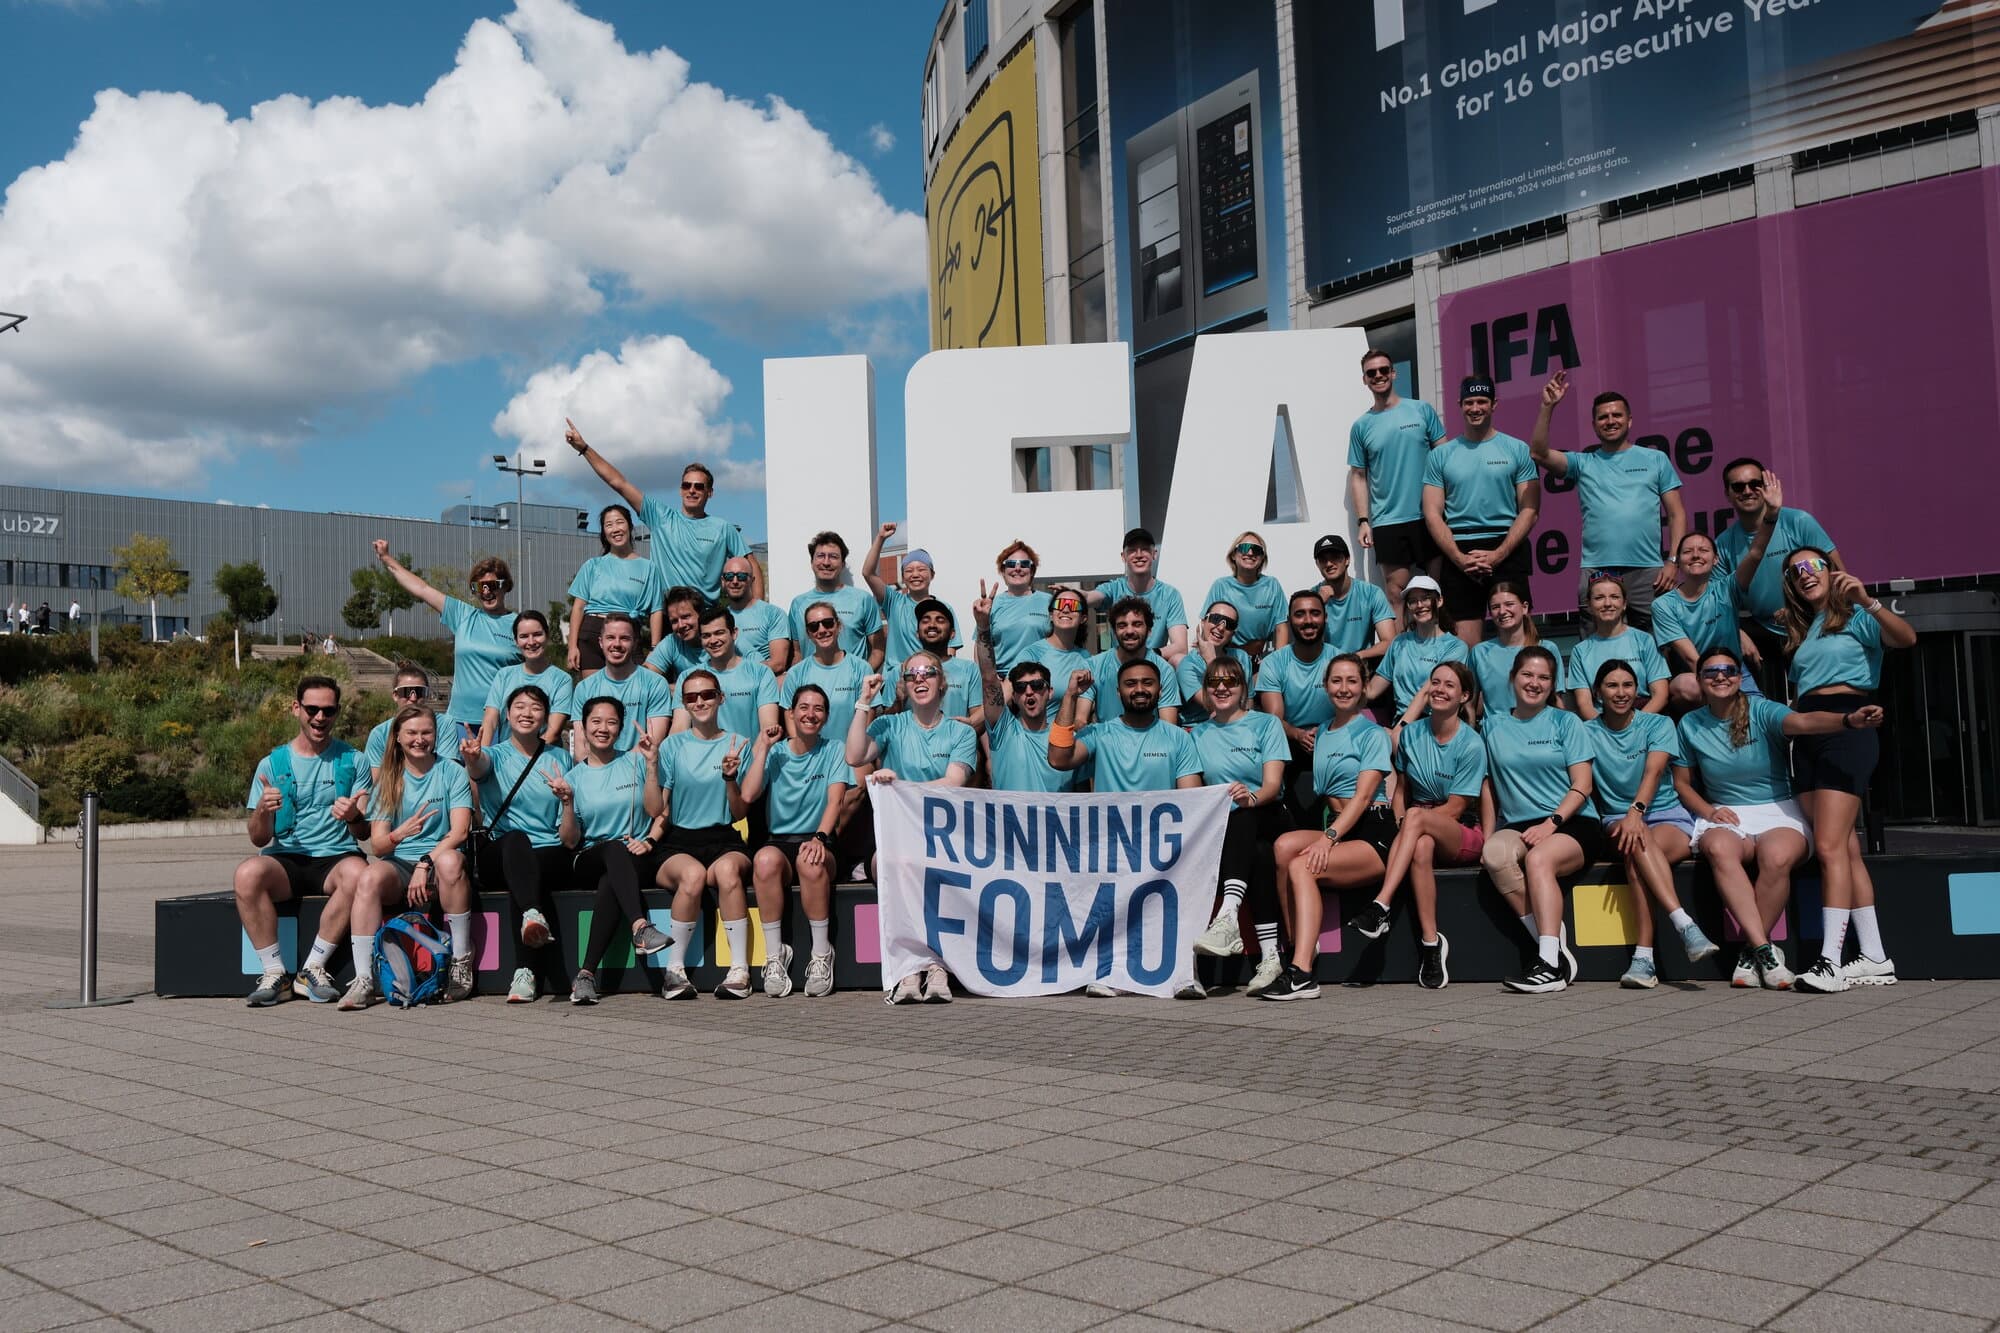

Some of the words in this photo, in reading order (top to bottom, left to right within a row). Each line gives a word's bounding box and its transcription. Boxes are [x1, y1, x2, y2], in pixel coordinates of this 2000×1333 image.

[1380, 72, 1432, 113] No.1
[1440, 35, 1527, 88] Global
[1537, 7, 1623, 54] Major
[1456, 90, 1494, 120] for
[1503, 73, 1534, 104] 16
[1542, 12, 1733, 88] Consecutive
[1744, 0, 1821, 22] Yea
[1386, 209, 1415, 224] Source:
[1468, 174, 1526, 198] International
[1567, 146, 1617, 167] Consumer
[1470, 196, 1487, 210] unit
[1488, 190, 1516, 206] share,
[1517, 181, 1539, 195] 2024
[1541, 171, 1575, 188] volume
[1577, 162, 1602, 177] sales
[1604, 153, 1631, 170] data.
[1471, 303, 1581, 384] IFA
[763, 326, 1382, 625] IFA
[3, 513, 59, 534] ub27
[923, 796, 1183, 873] RUNNING
[923, 867, 1179, 987] FOMO
